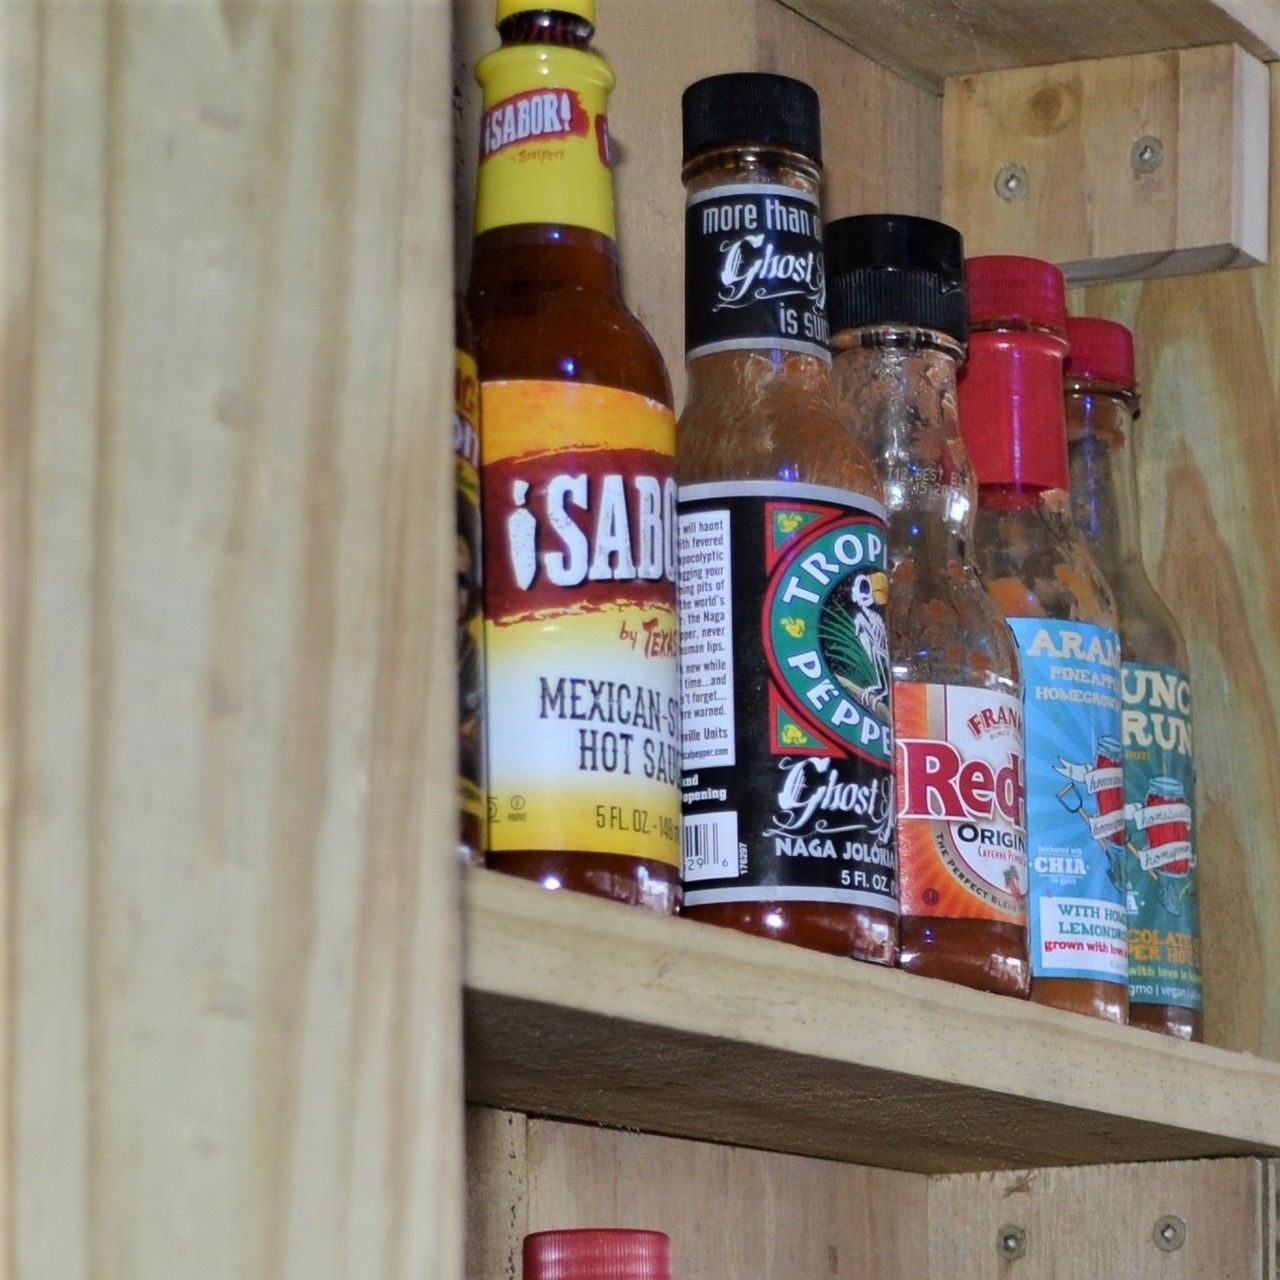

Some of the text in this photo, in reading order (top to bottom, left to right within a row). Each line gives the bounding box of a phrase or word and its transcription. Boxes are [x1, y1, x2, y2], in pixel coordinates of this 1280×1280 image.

[485, 92, 571, 154] ¡SABOR!
[703, 204, 758, 234] more
[765, 199, 810, 236] than
[714, 233, 816, 305] Ghost
[779, 302, 798, 334] is
[618, 620, 638, 650] by
[704, 728, 728, 740] Units
[579, 728, 634, 775] HOT
[766, 756, 880, 834] Ghost
[595, 804, 606, 829] 5
[774, 837, 838, 859] NAGA
[841, 870, 851, 886] 5
[936, 833, 949, 858] THE
[947, 859, 989, 900] PERFECT
[1033, 857, 1088, 876] CHIA
[1057, 903, 1100, 920] WITH
[1043, 940, 1084, 953] grown
[1086, 941, 1109, 953] with
